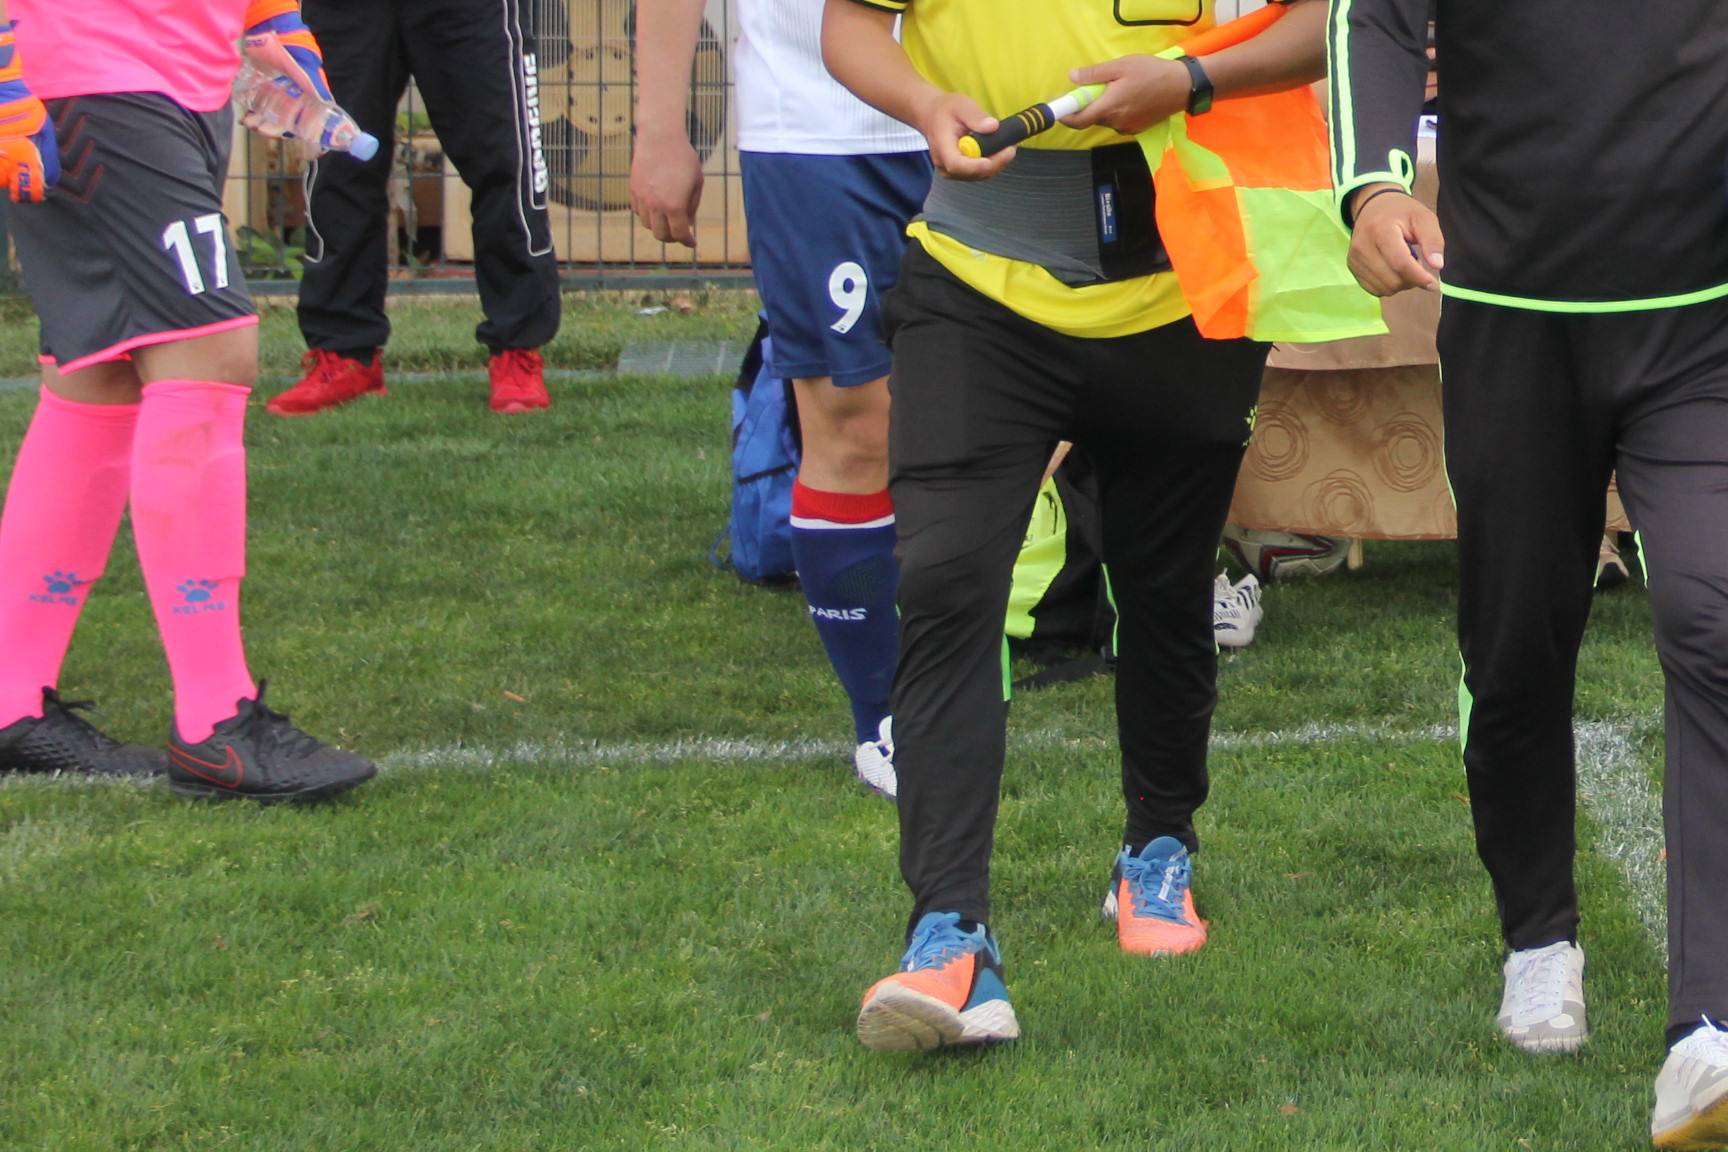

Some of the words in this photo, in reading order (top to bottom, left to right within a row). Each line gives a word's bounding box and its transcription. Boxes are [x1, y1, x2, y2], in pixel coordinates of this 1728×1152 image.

[163, 212, 229, 295] 17
[829, 261, 868, 334] 9
[808, 605, 868, 620] PARIS
